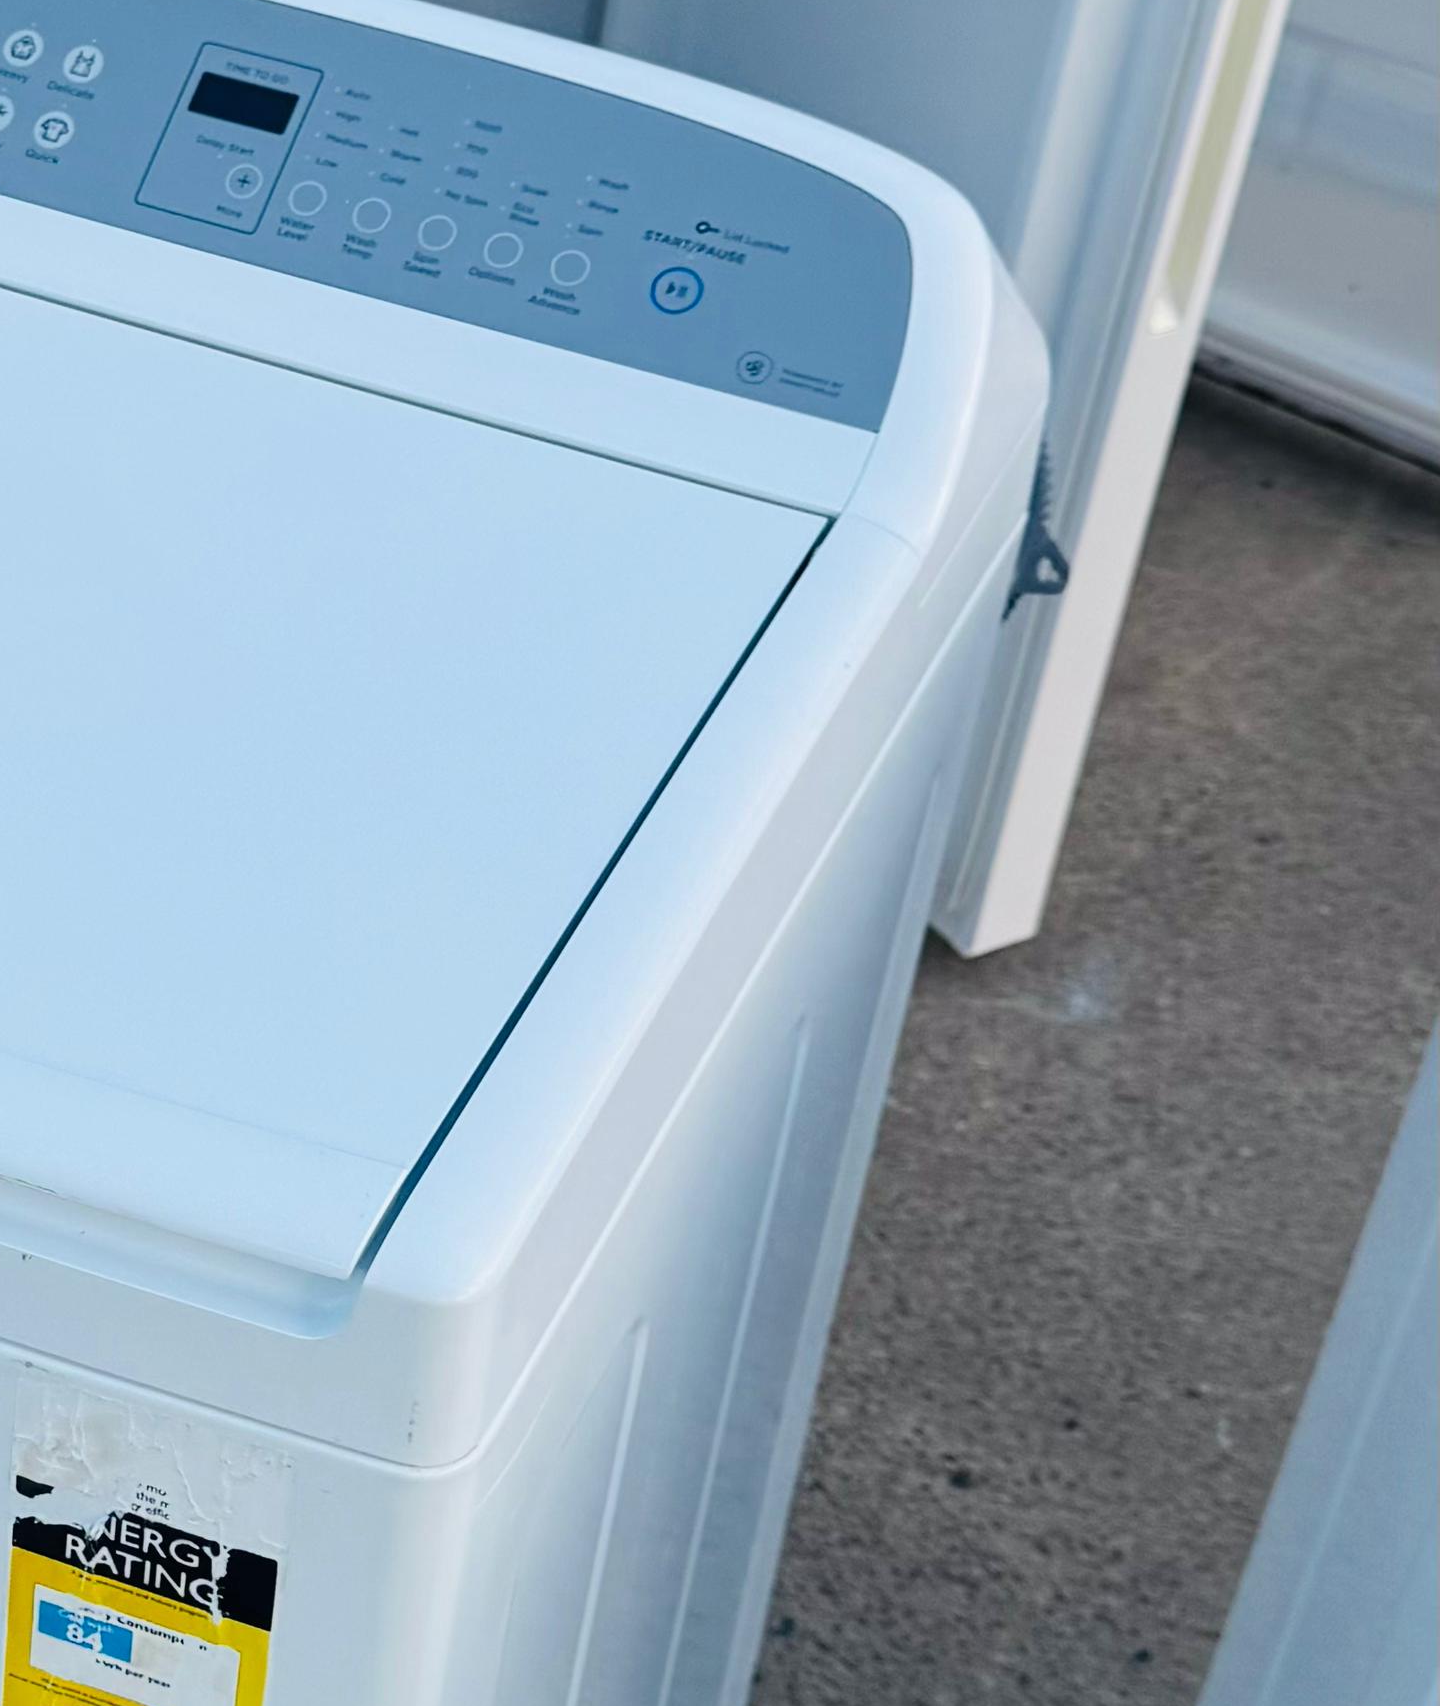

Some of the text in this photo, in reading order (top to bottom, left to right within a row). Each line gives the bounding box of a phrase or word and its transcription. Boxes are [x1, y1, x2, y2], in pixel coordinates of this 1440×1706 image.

[279, 215, 316, 231] Water
[642, 229, 748, 266] START/PAUSE
[64, 1532, 224, 1608] RATING
[100, 1513, 230, 1579] NERGY
